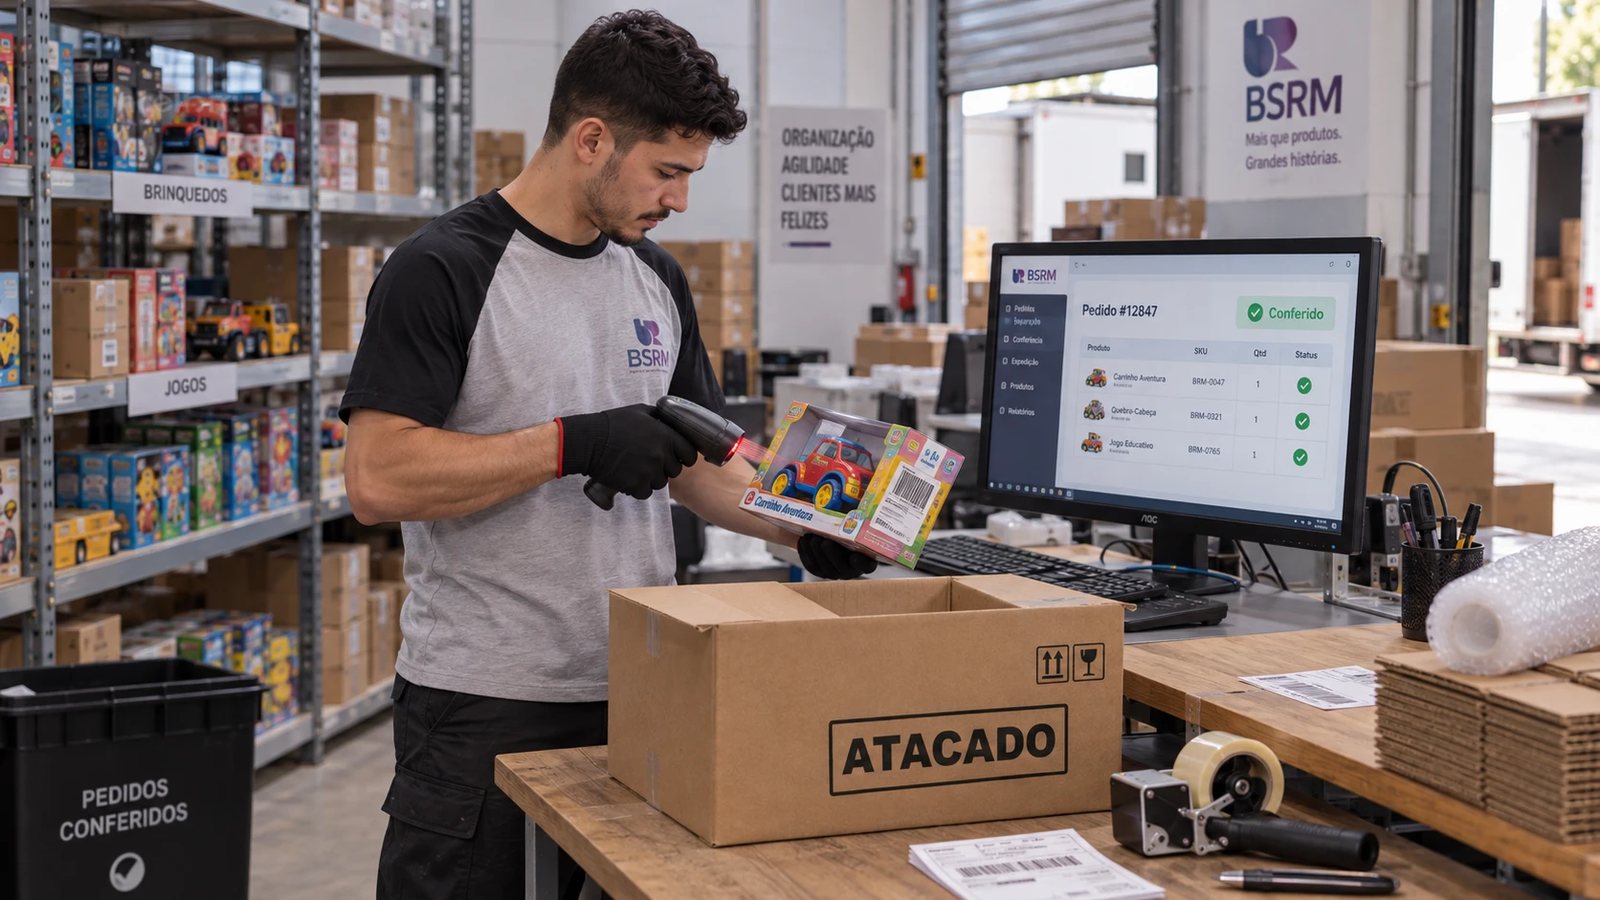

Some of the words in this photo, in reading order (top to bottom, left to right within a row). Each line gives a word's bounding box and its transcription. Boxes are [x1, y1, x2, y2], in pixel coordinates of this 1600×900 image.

[1246, 74, 1343, 122] BSRM
[782, 126, 874, 153] ORGANIZAÇÃO
[1246, 132, 1268, 147] Mais
[1270, 133, 1290, 148] que
[1291, 126, 1342, 146] produtos.
[782, 156, 849, 175] AGILIDADE
[1246, 153, 1288, 170] Grandes
[1290, 151, 1342, 167] histórias.
[144, 183, 228, 203] BRINQUEDOS
[782, 183, 841, 203] CLIENTES
[844, 184, 876, 203] MAIS
[781, 211, 829, 230] FELIZES
[1027, 269, 1057, 281] BSRM
[1082, 303, 1117, 316] Pedido
[1119, 305, 1158, 317] #12847
[1268, 307, 1324, 320] Conferido
[1087, 343, 1111, 352] Produto
[1193, 347, 1208, 355] SKU
[1253, 349, 1267, 357] Qtd
[1295, 350, 1318, 359] Status
[627, 348, 669, 368] BSRM
[164, 376, 207, 397] JOGOS
[1009, 382, 1034, 391] Produtos
[1113, 372, 1139, 382] Carrinho
[1139, 374, 1166, 384] Aventura
[1190, 411, 1222, 421] BRM-0321
[1109, 439, 1124, 449] Jogo
[1188, 445, 1221, 455] BRM-0765
[842, 722, 1056, 776] ATACADO
[82, 778, 169, 809] PEDIDOS
[59, 802, 188, 841] CONFERIDOS
